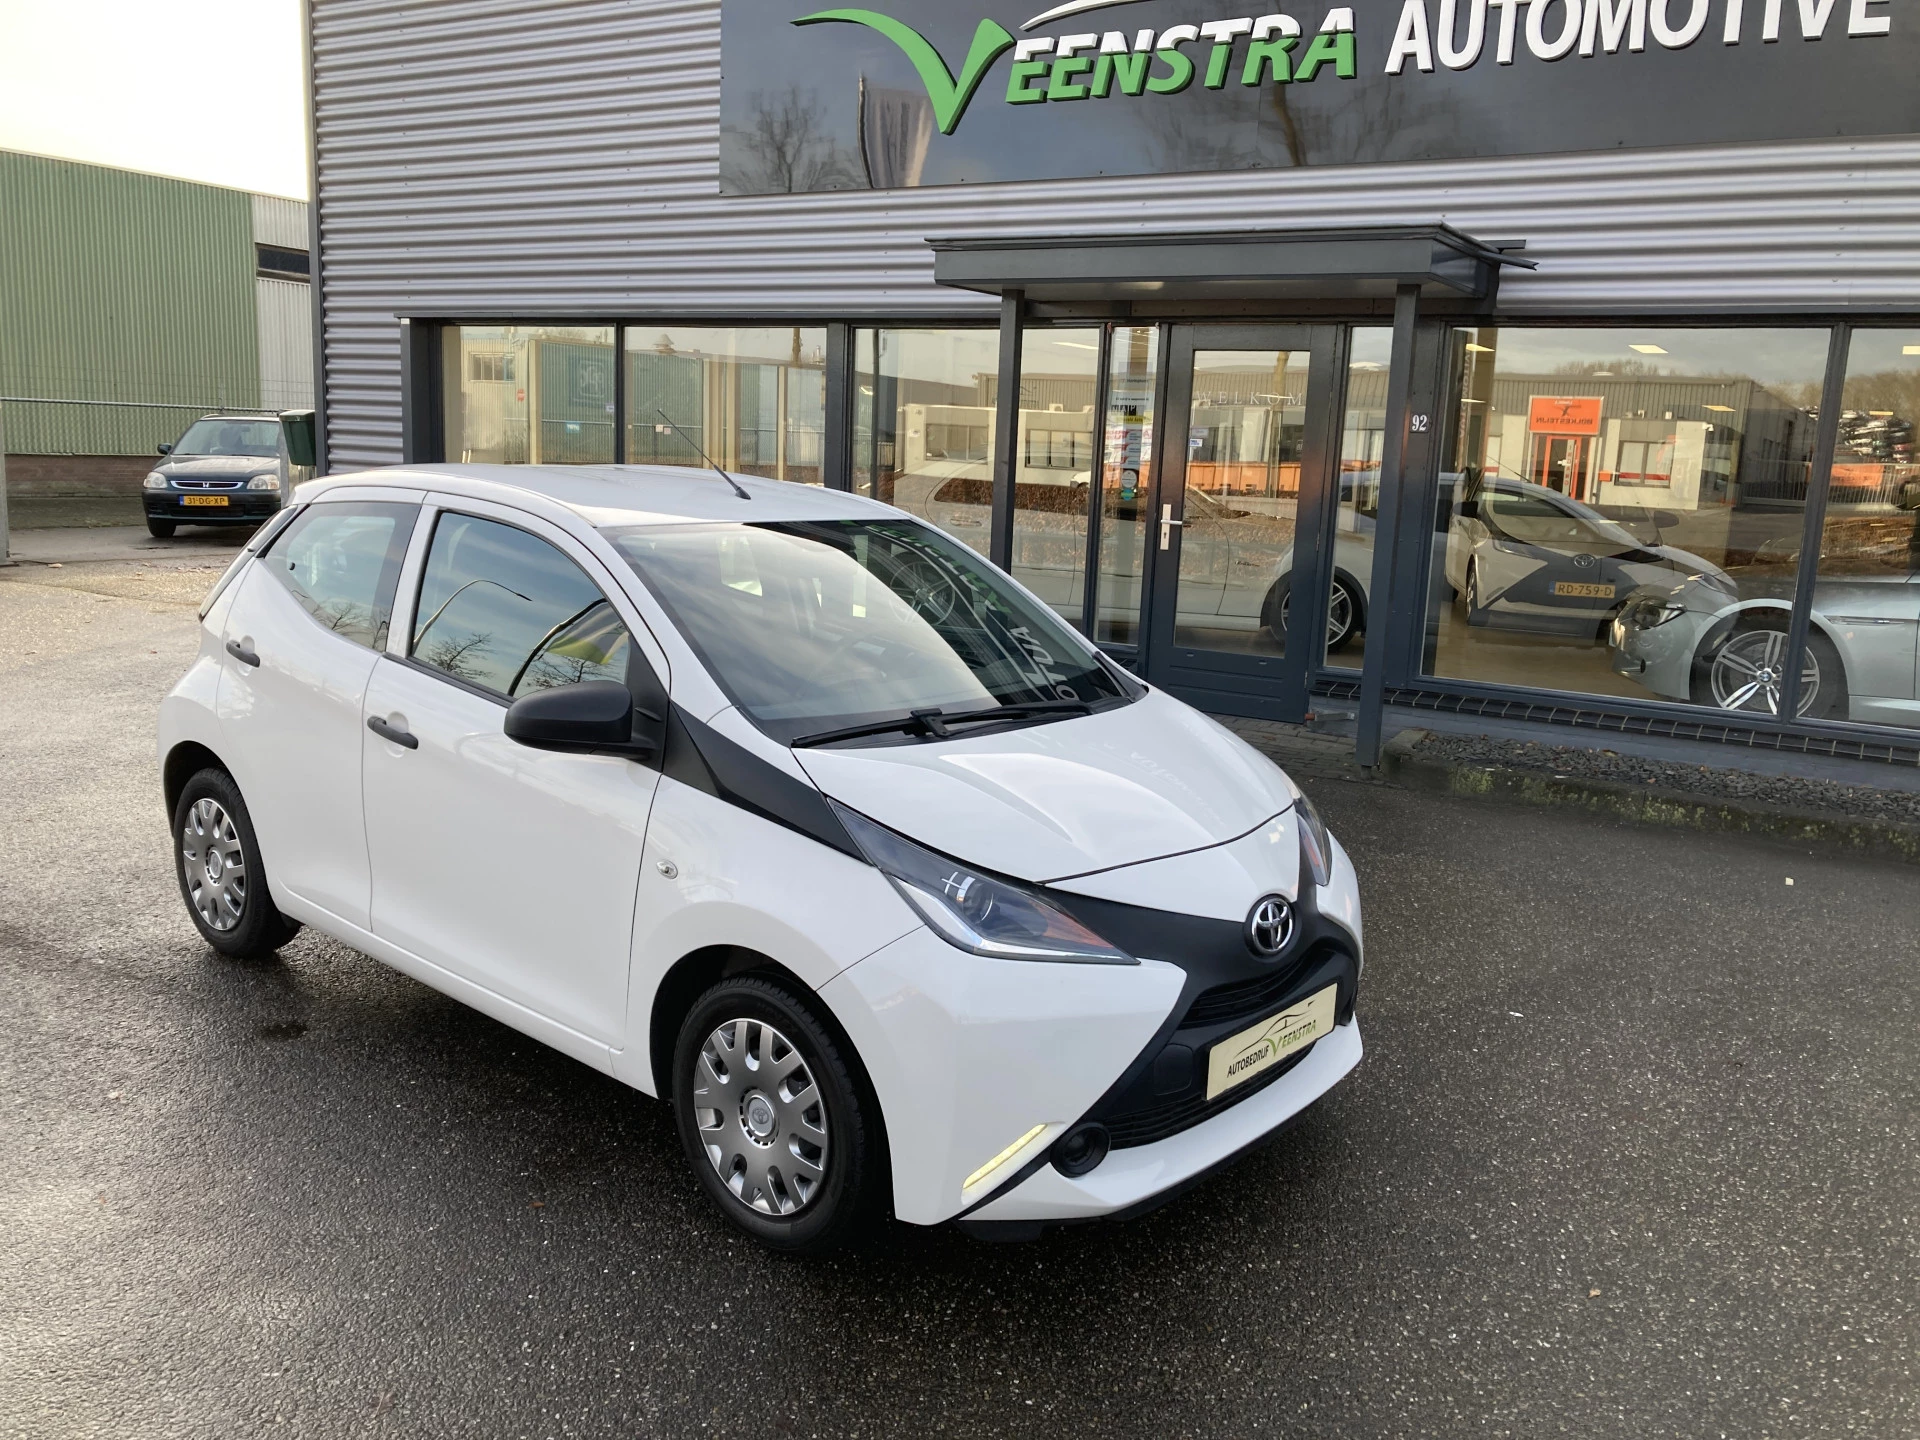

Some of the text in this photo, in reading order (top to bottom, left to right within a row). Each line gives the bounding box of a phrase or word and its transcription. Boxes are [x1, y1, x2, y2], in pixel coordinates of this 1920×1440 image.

[790, 7, 1356, 136] VEENSTRA
[1195, 390, 1303, 406] WELKOM
[1411, 414, 1428, 431] 92
[187, 496, 225, 505] 31-DG-XP
[1558, 585, 1612, 596] RD-759-D
[1227, 1019, 1316, 1078] AUTOBEDRIJF VEENSTRA
